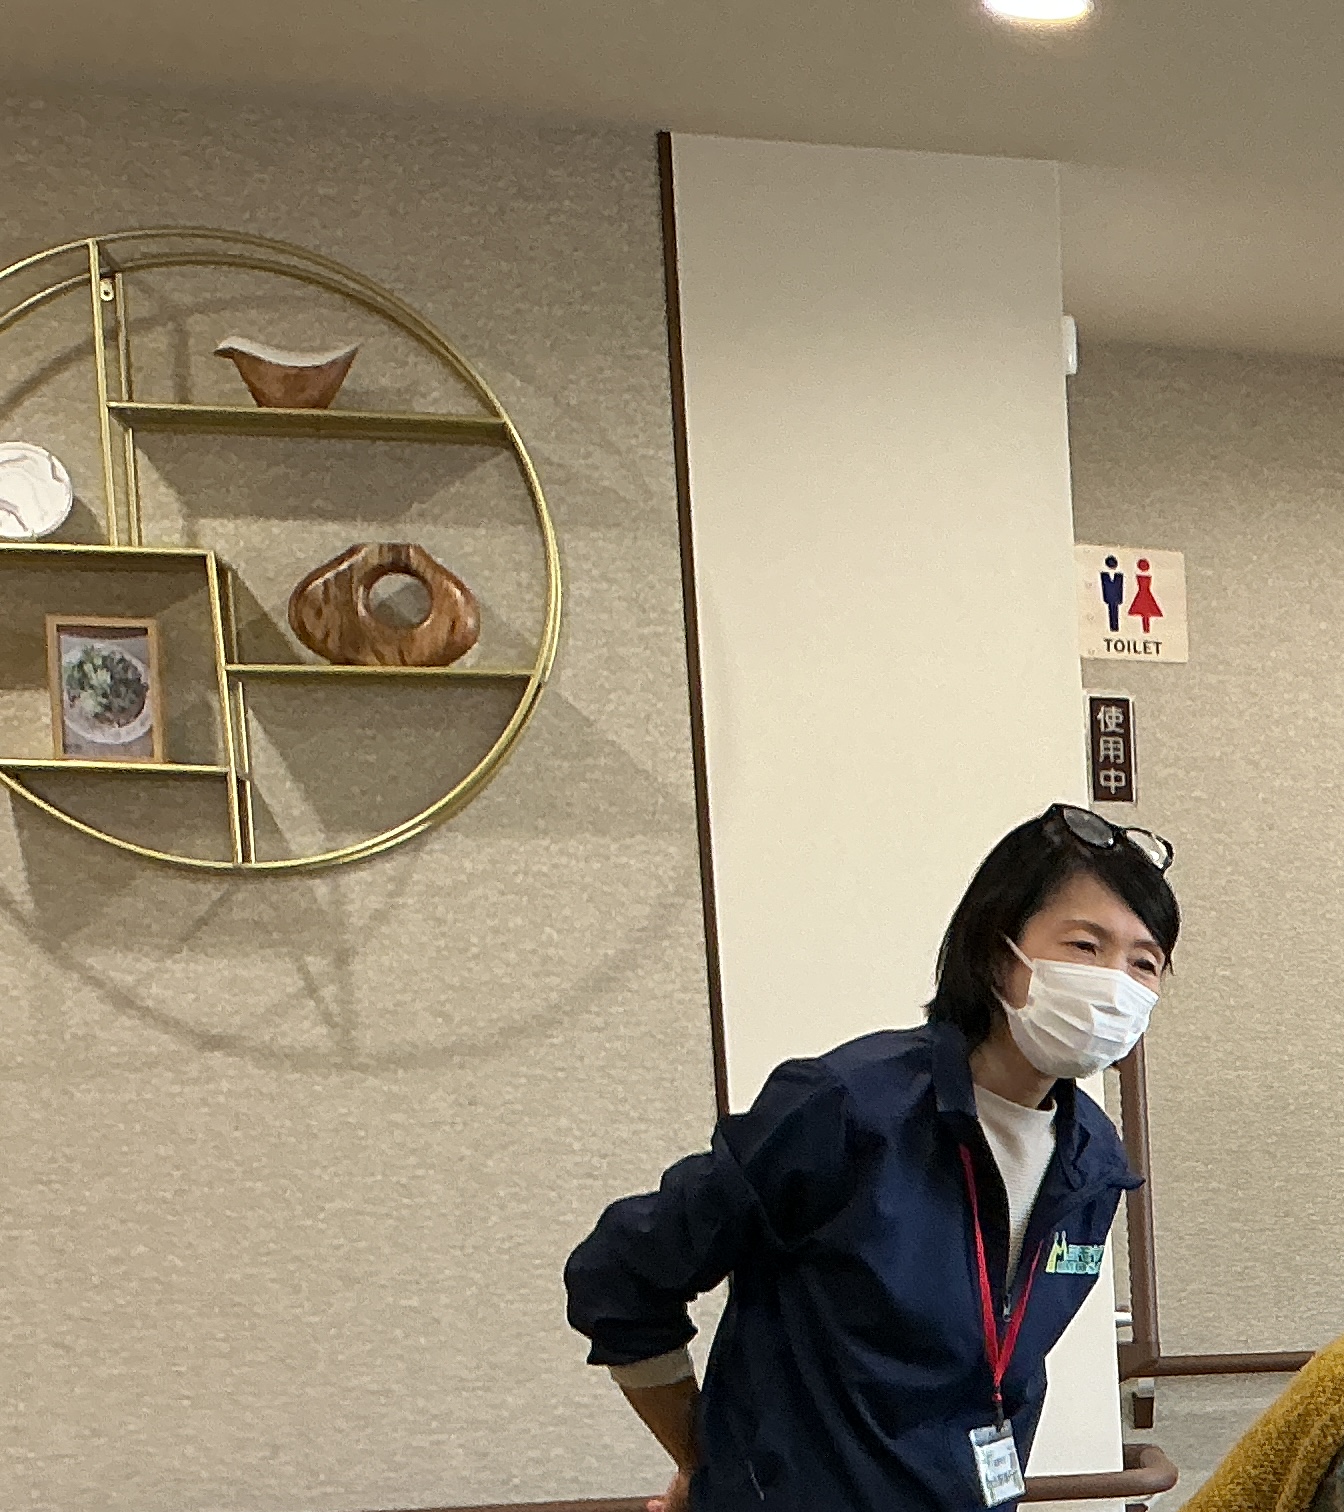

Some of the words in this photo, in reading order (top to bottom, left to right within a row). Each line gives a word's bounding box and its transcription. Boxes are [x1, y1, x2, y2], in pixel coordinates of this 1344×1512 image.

[1103, 637, 1163, 656] TOILET
[1097, 704, 1127, 795] 使用中
